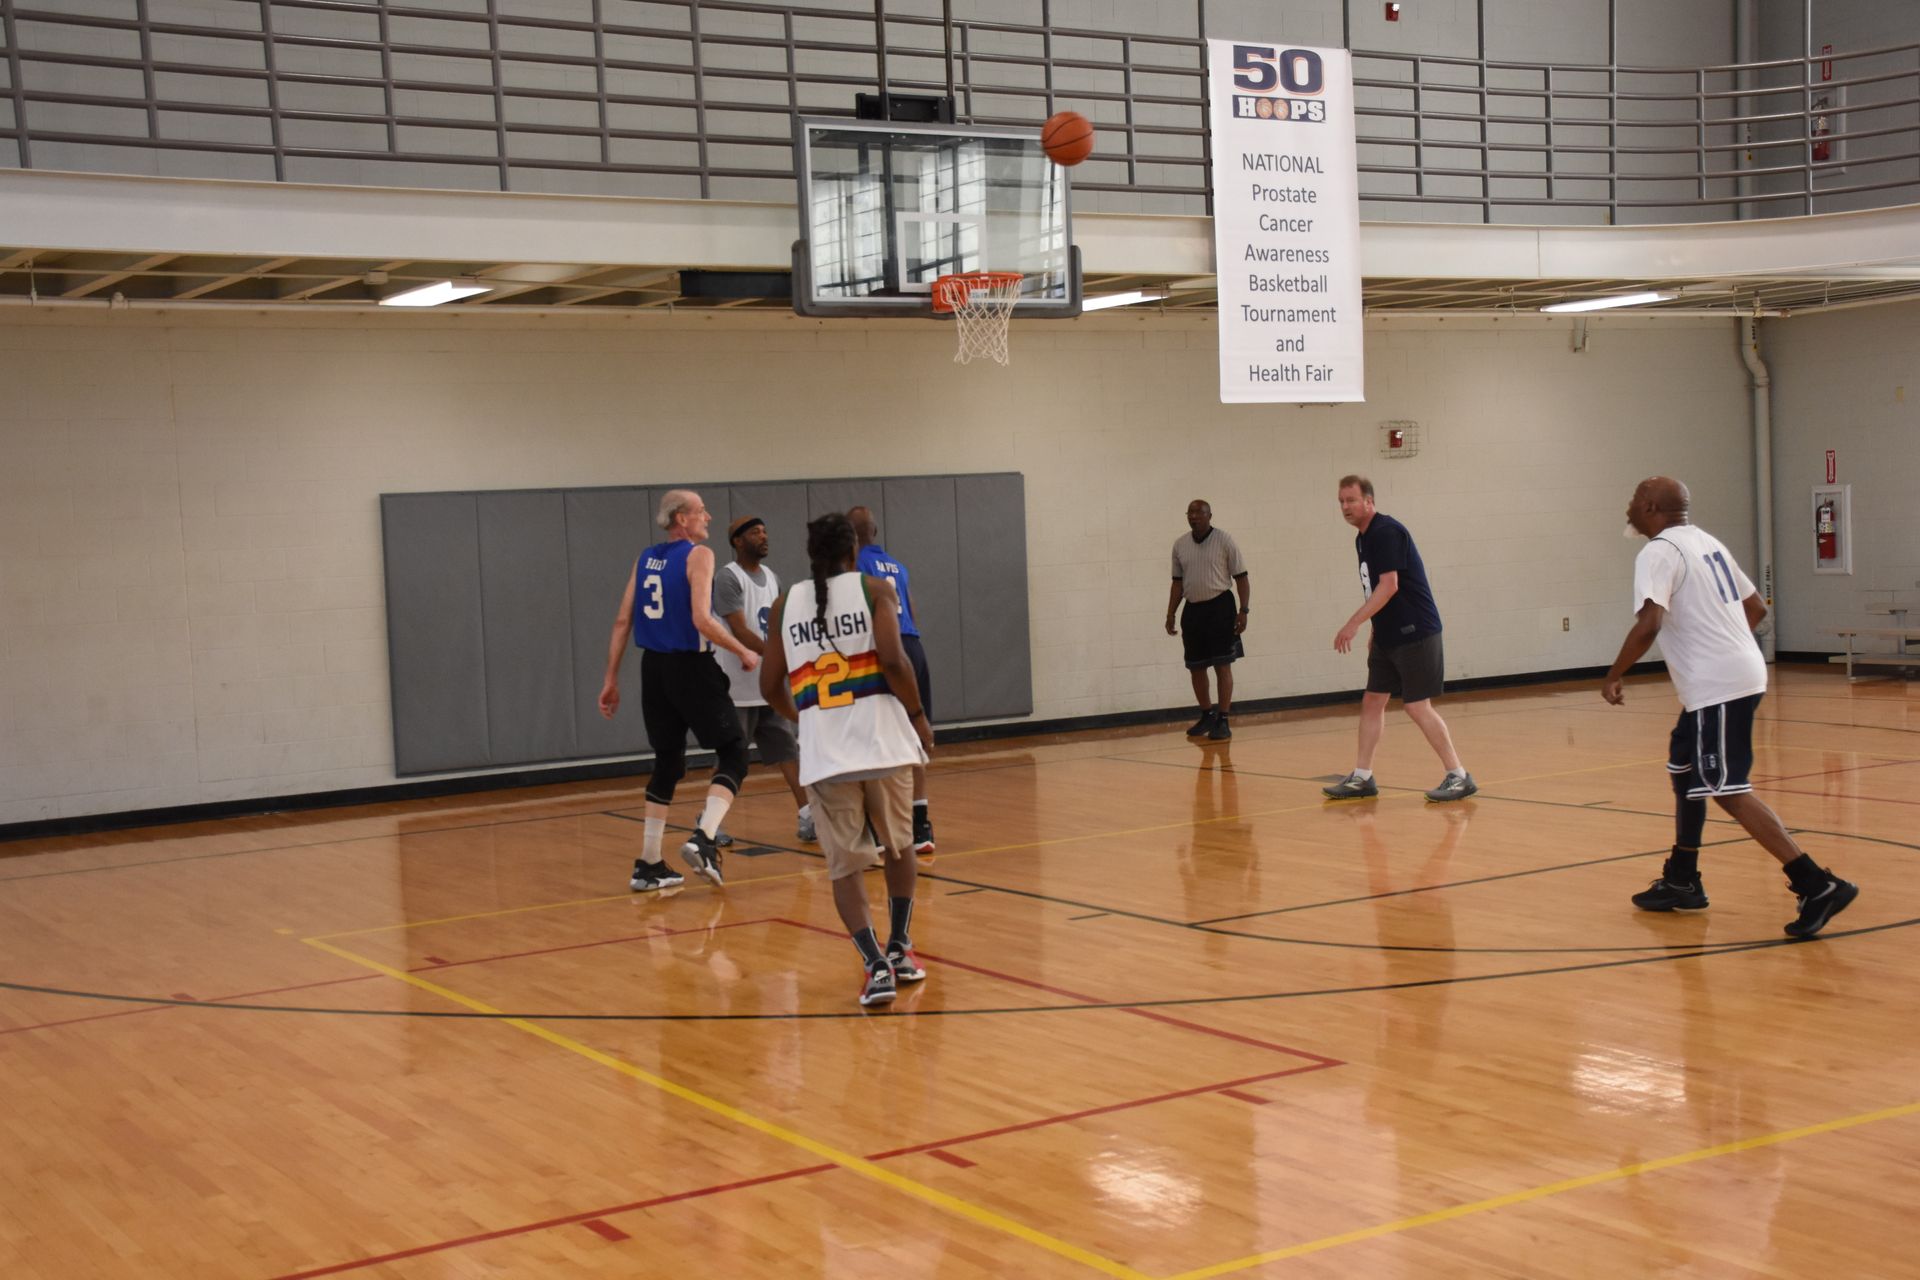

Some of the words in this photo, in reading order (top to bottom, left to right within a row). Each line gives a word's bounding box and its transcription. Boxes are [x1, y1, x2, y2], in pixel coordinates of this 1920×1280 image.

[1233, 45, 1325, 96] 50
[1237, 97, 1325, 122] HOOPS
[1242, 153, 1324, 174] NATIONAL
[1252, 184, 1317, 203] Prostate
[1259, 214, 1313, 232] Cancer
[1244, 244, 1330, 263] Awareness
[1249, 274, 1328, 293] Basketball
[1241, 305, 1337, 323] Tournament
[1276, 334, 1305, 352] and
[1249, 364, 1300, 382] Health
[1305, 364, 1334, 381] Fair
[1703, 551, 1739, 603] 11
[643, 574, 664, 619] 3
[814, 651, 855, 710] 2
